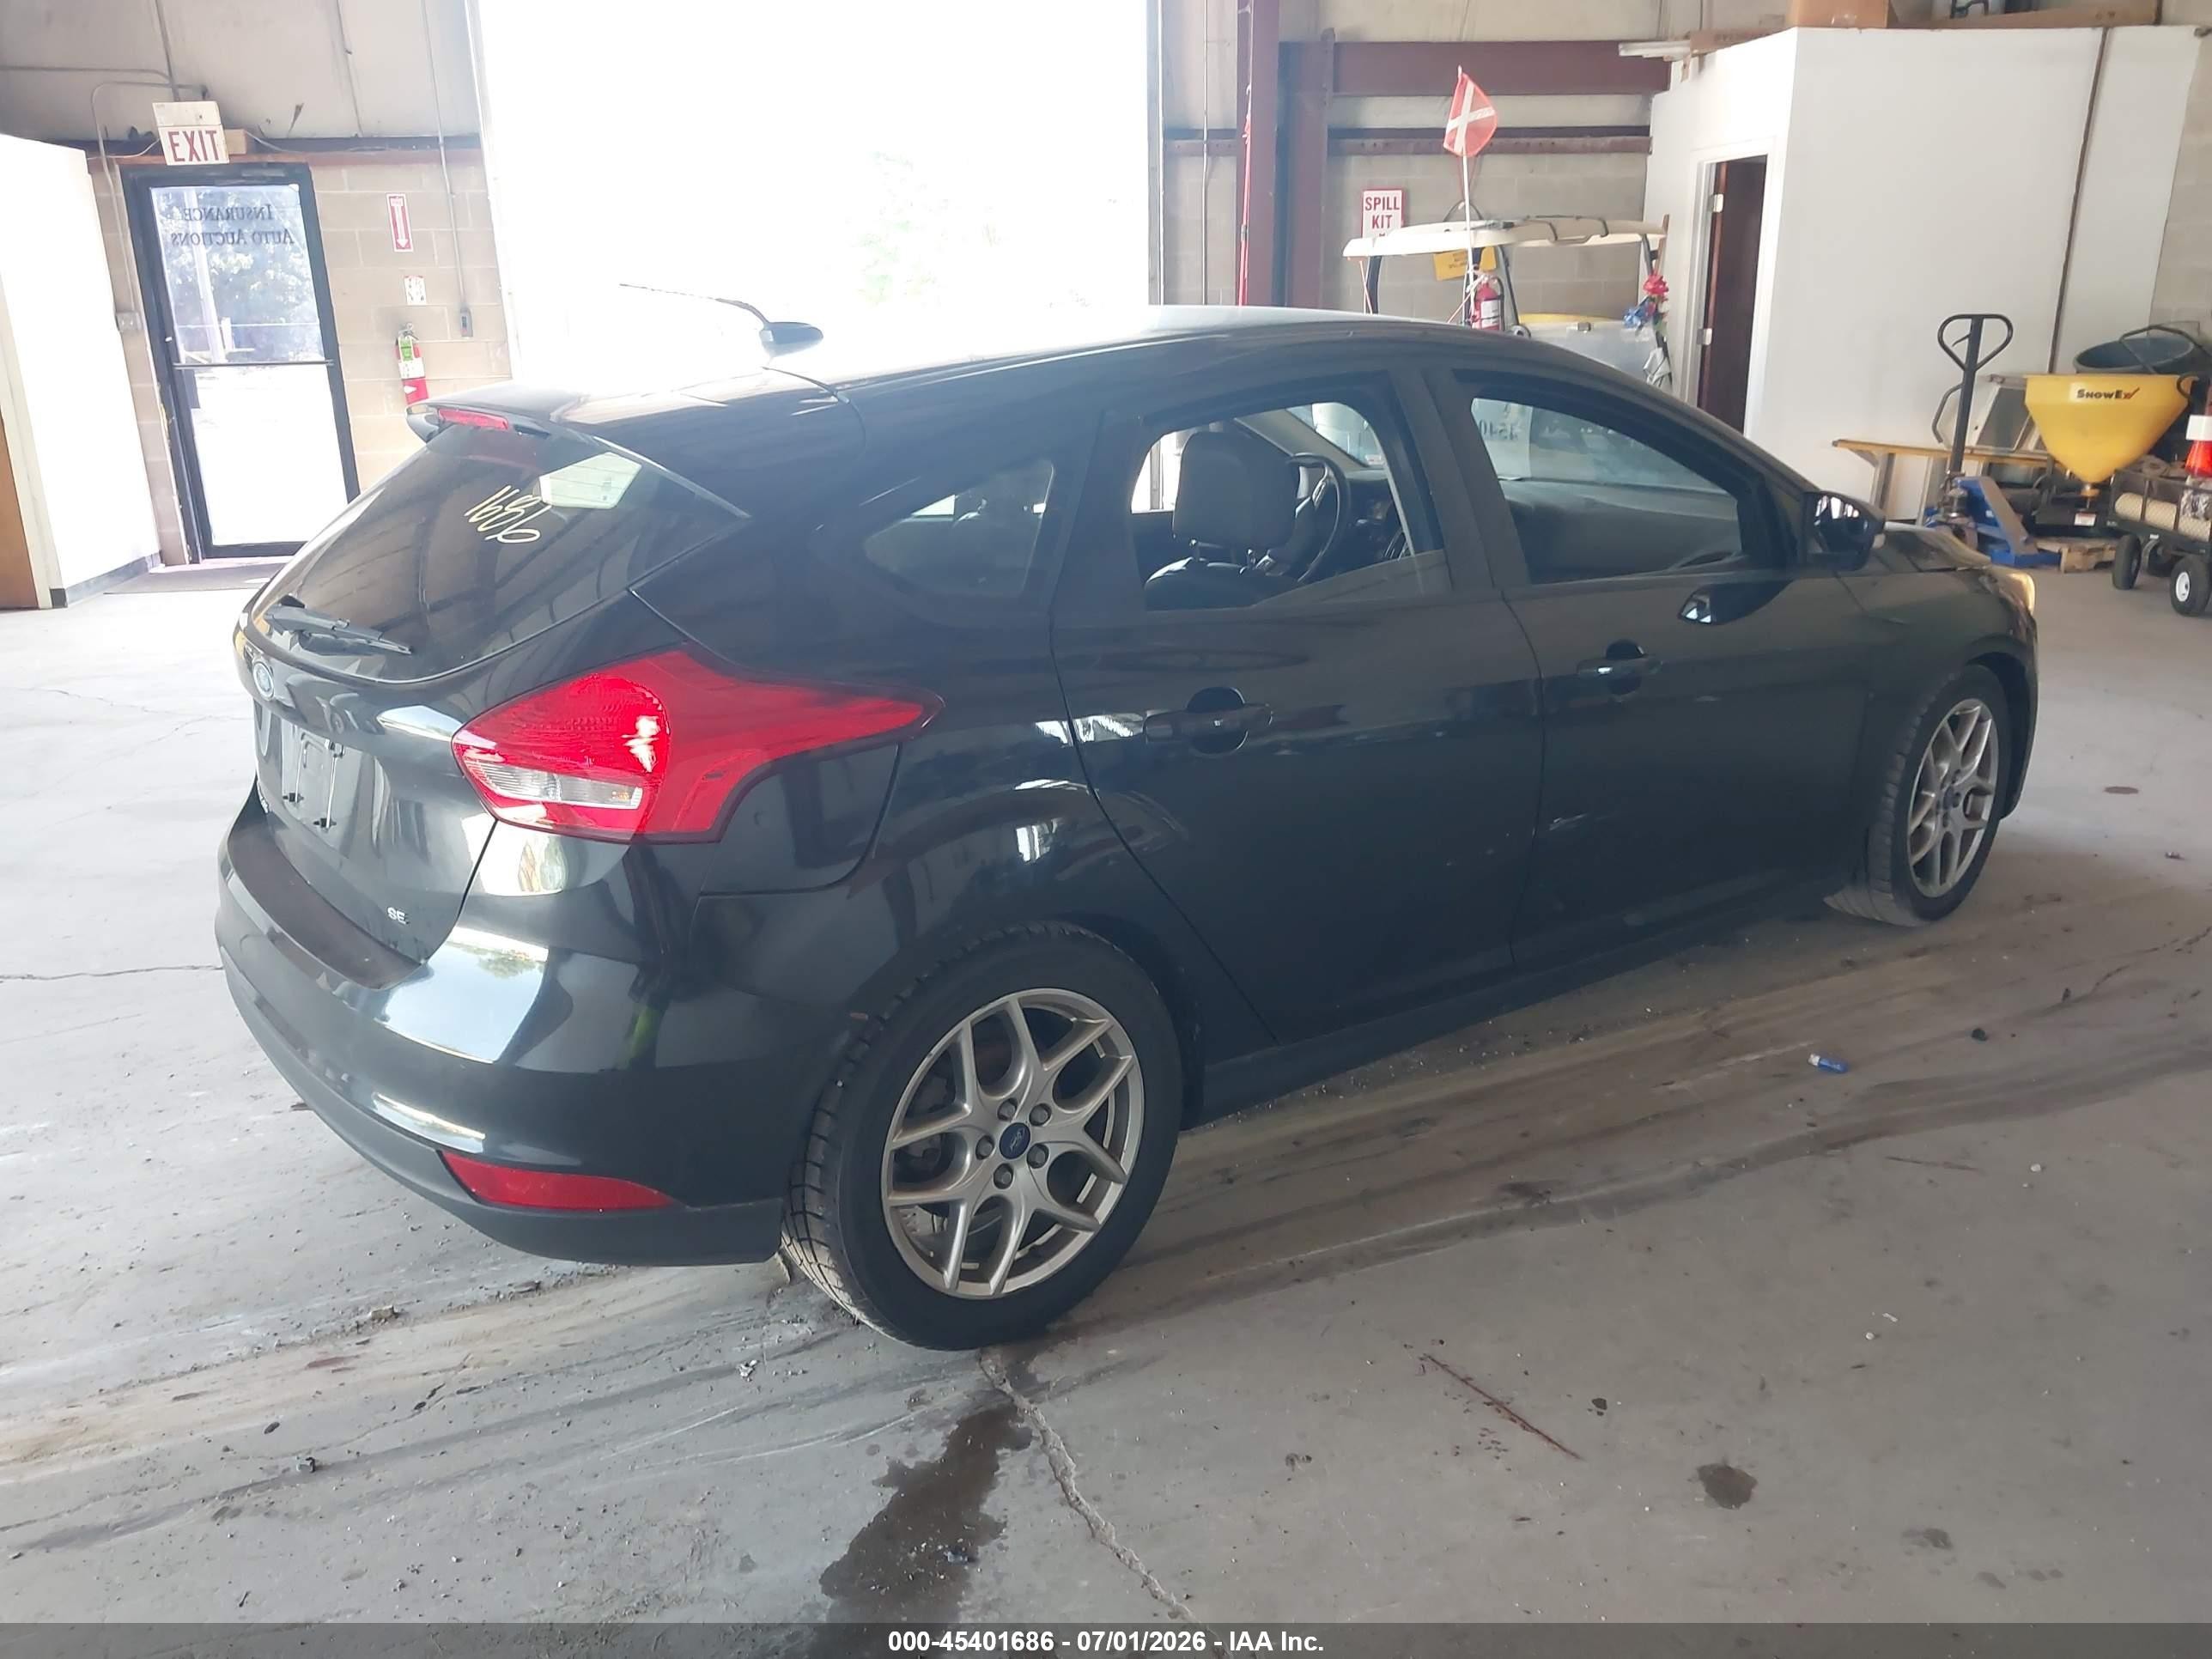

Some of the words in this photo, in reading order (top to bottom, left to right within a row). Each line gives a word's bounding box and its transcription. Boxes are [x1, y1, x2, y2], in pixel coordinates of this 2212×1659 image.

[167, 130, 219, 162] EXIT
[1365, 196, 1400, 211] SPILL
[1372, 215, 1393, 229] KIT
[464, 485, 552, 544] 1686
[387, 907, 406, 925] SE
